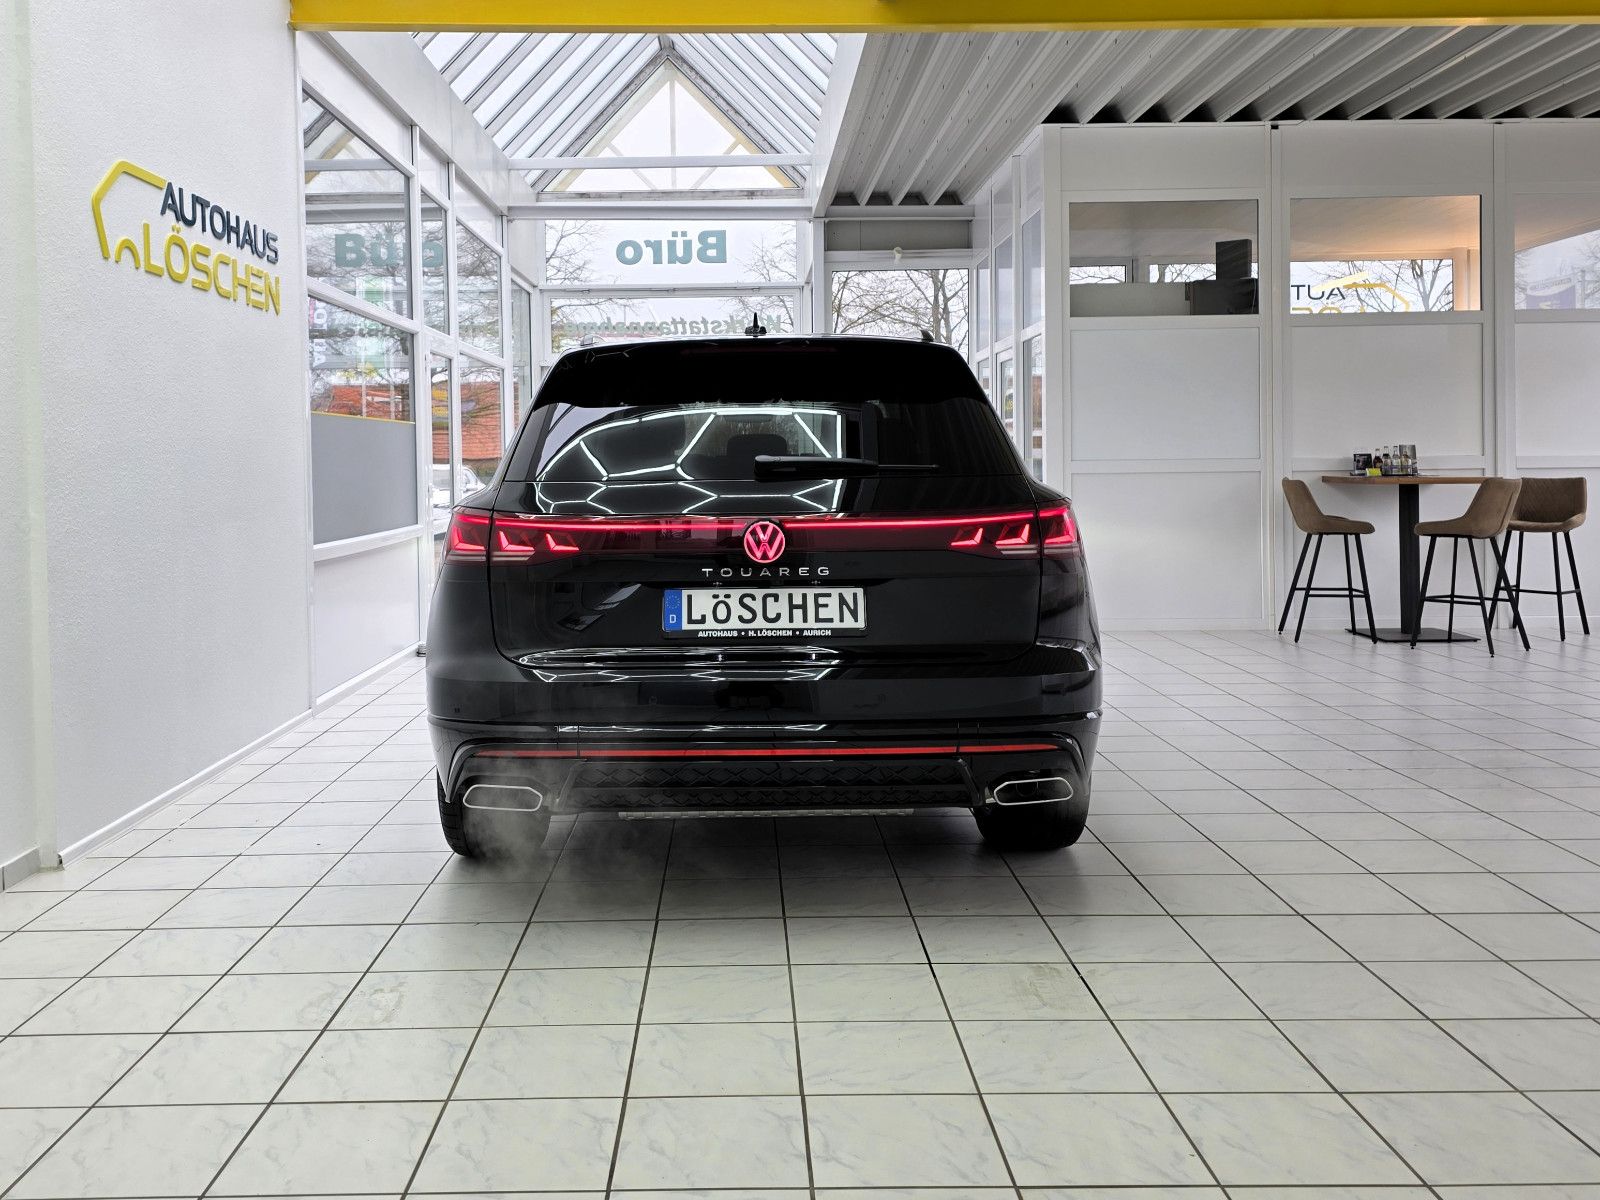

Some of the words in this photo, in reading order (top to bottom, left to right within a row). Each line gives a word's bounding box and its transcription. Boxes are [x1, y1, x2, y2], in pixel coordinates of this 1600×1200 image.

[160, 181, 279, 264] AUTOHAUS
[142, 220, 281, 315] LÖSCHEN
[335, 233, 444, 268] Büo
[744, 521, 786, 563] VW
[701, 567, 830, 577] TOUAREG
[669, 614, 677, 624] D
[686, 592, 859, 625] LÖSCHEN
[758, 629, 793, 637] LÖSCHEN
